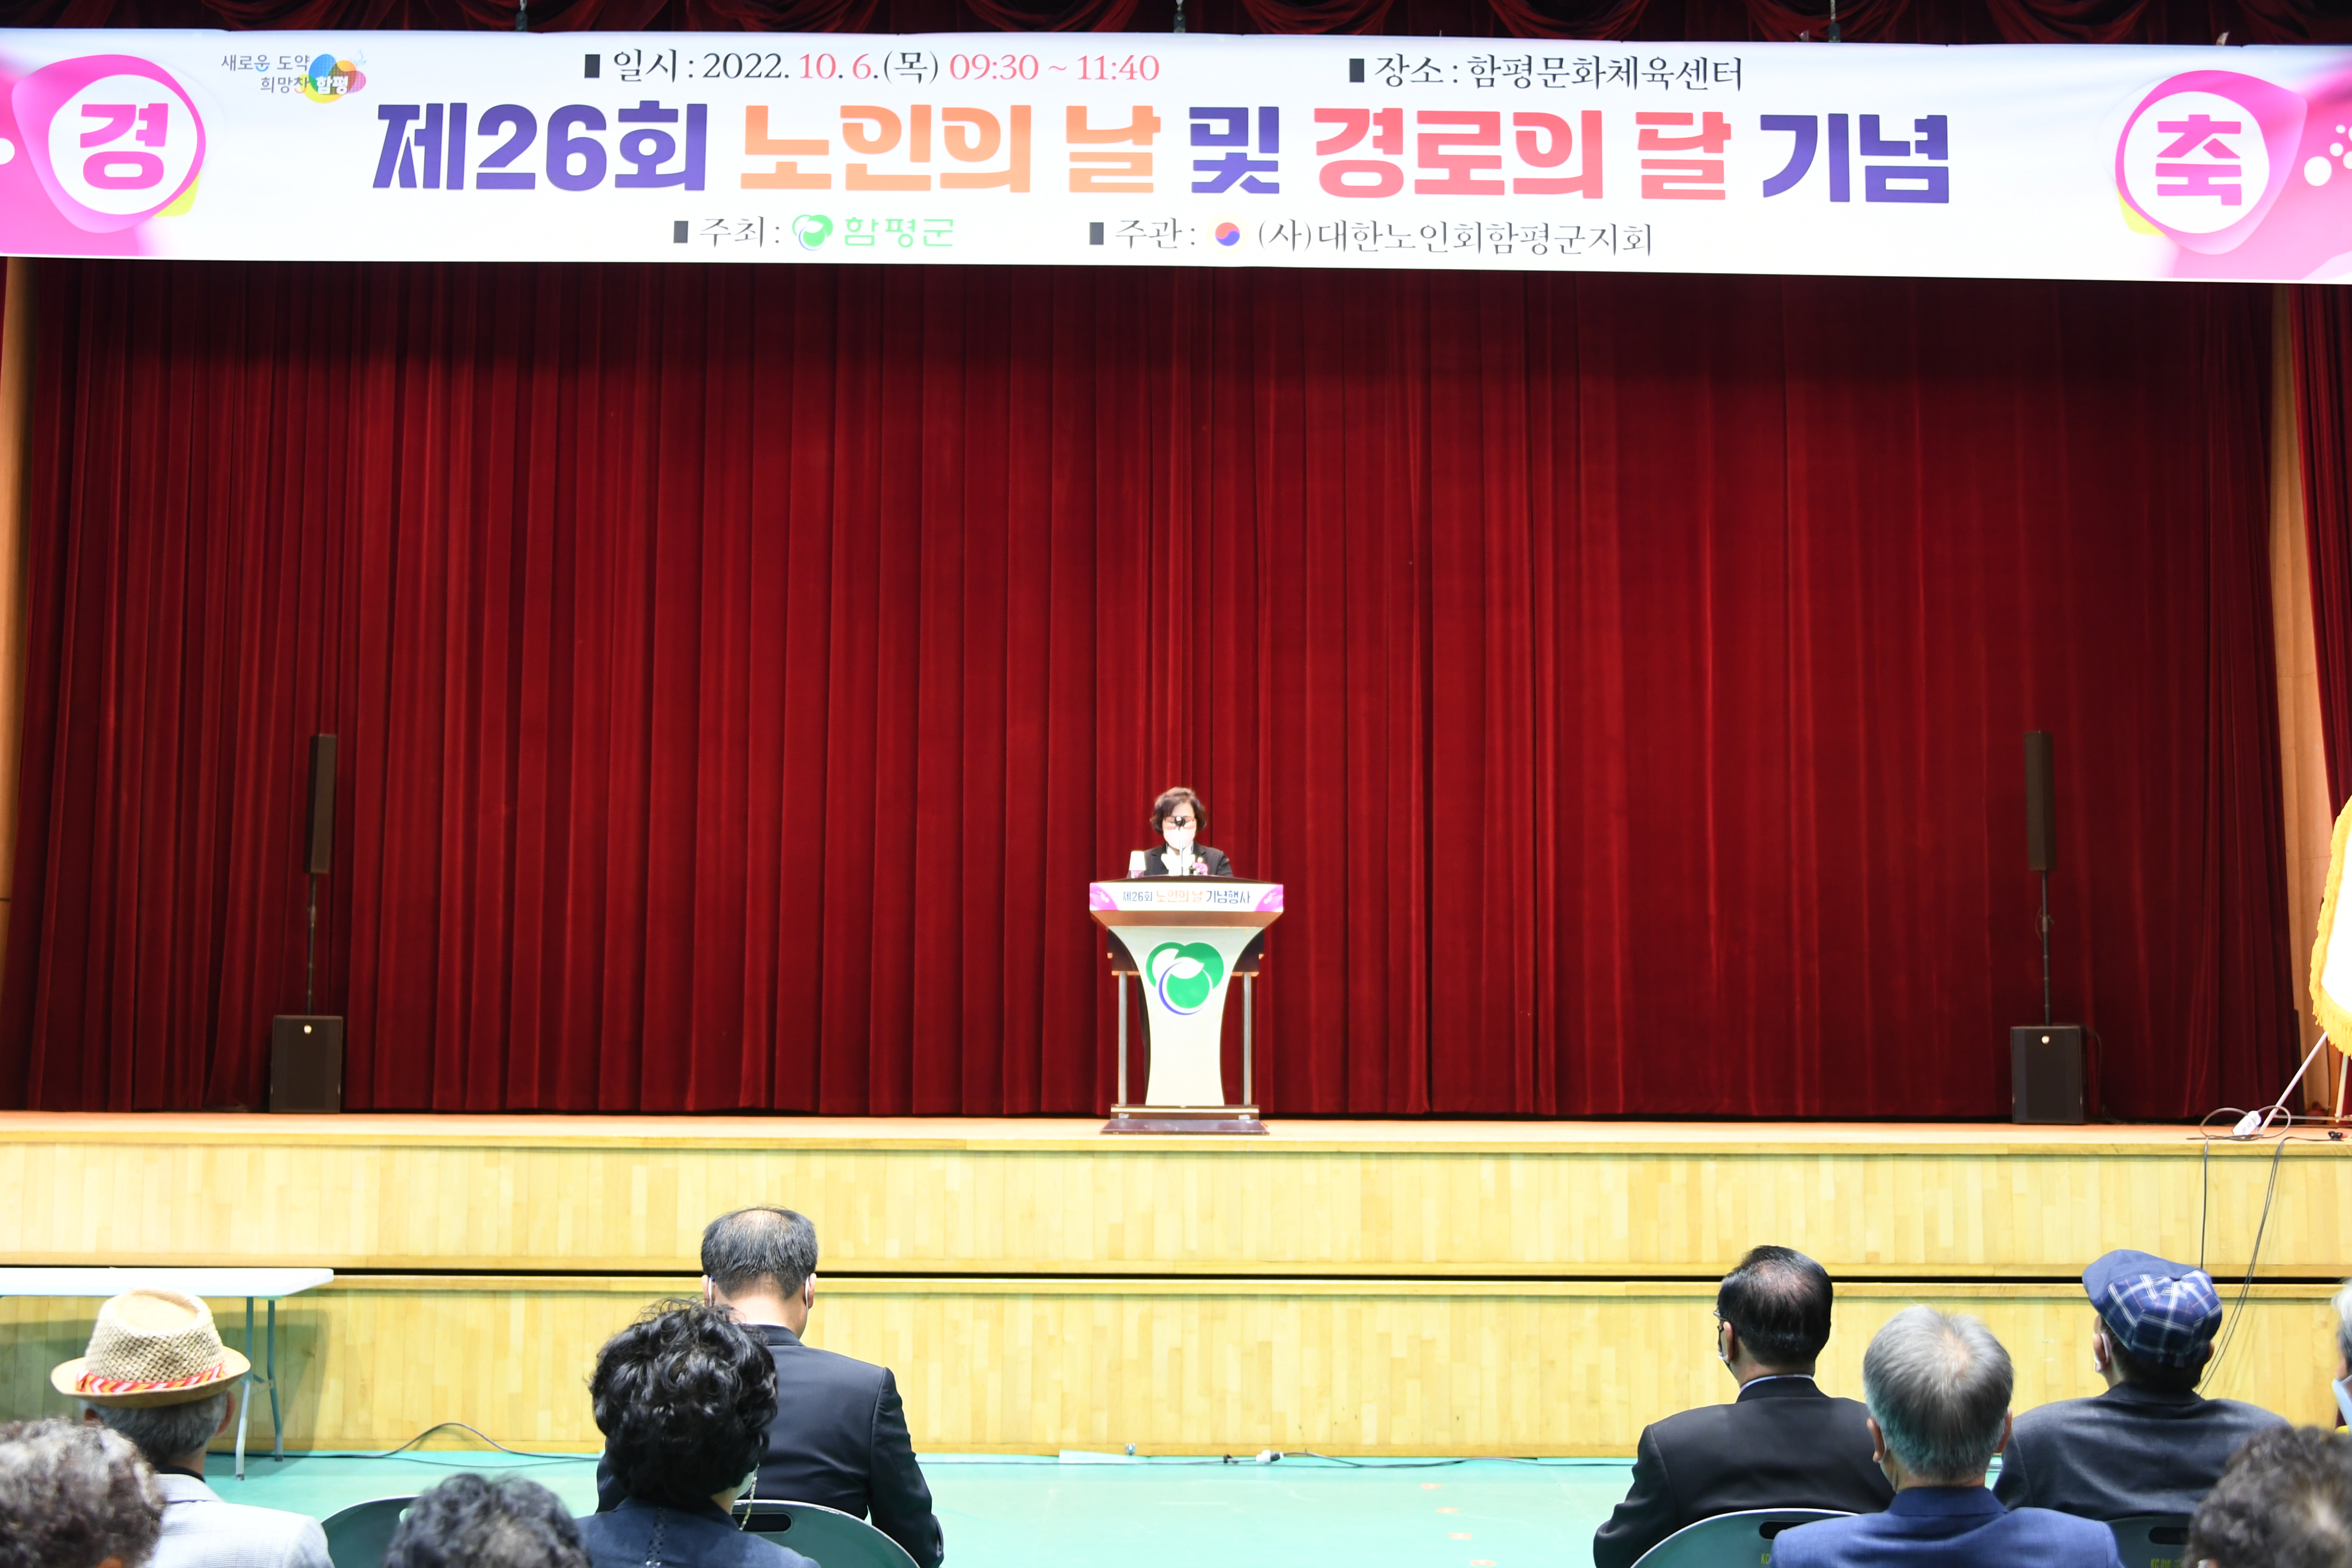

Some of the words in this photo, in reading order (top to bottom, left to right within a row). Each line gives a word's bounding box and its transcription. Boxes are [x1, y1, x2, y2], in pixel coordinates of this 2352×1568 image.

[221, 54, 270, 72] 새로운
[277, 54, 310, 71] 도약
[702, 52, 789, 79] 2022.
[949, 53, 1039, 81] 09:30
[1077, 54, 1160, 81] 11:40
[1466, 53, 1742, 92] 함평문화체육센터
[260, 76, 310, 94] 희망찬
[316, 75, 348, 95] 함평
[80, 103, 169, 190] 경
[372, 100, 708, 192] 제26회
[740, 104, 1032, 193] 노인의
[1066, 105, 1161, 193] 날
[1189, 106, 1279, 194] 및
[1314, 108, 1603, 199] 경로의
[1635, 112, 1731, 200] 달
[1760, 113, 1949, 204] 기념
[2155, 114, 2242, 206] 축
[844, 216, 954, 248] 함평군
[1123, 891, 1152, 902] 제26회
[1156, 890, 1189, 903] 노인의
[1192, 890, 1203, 903] 날
[1206, 890, 1250, 904] 기념행사
